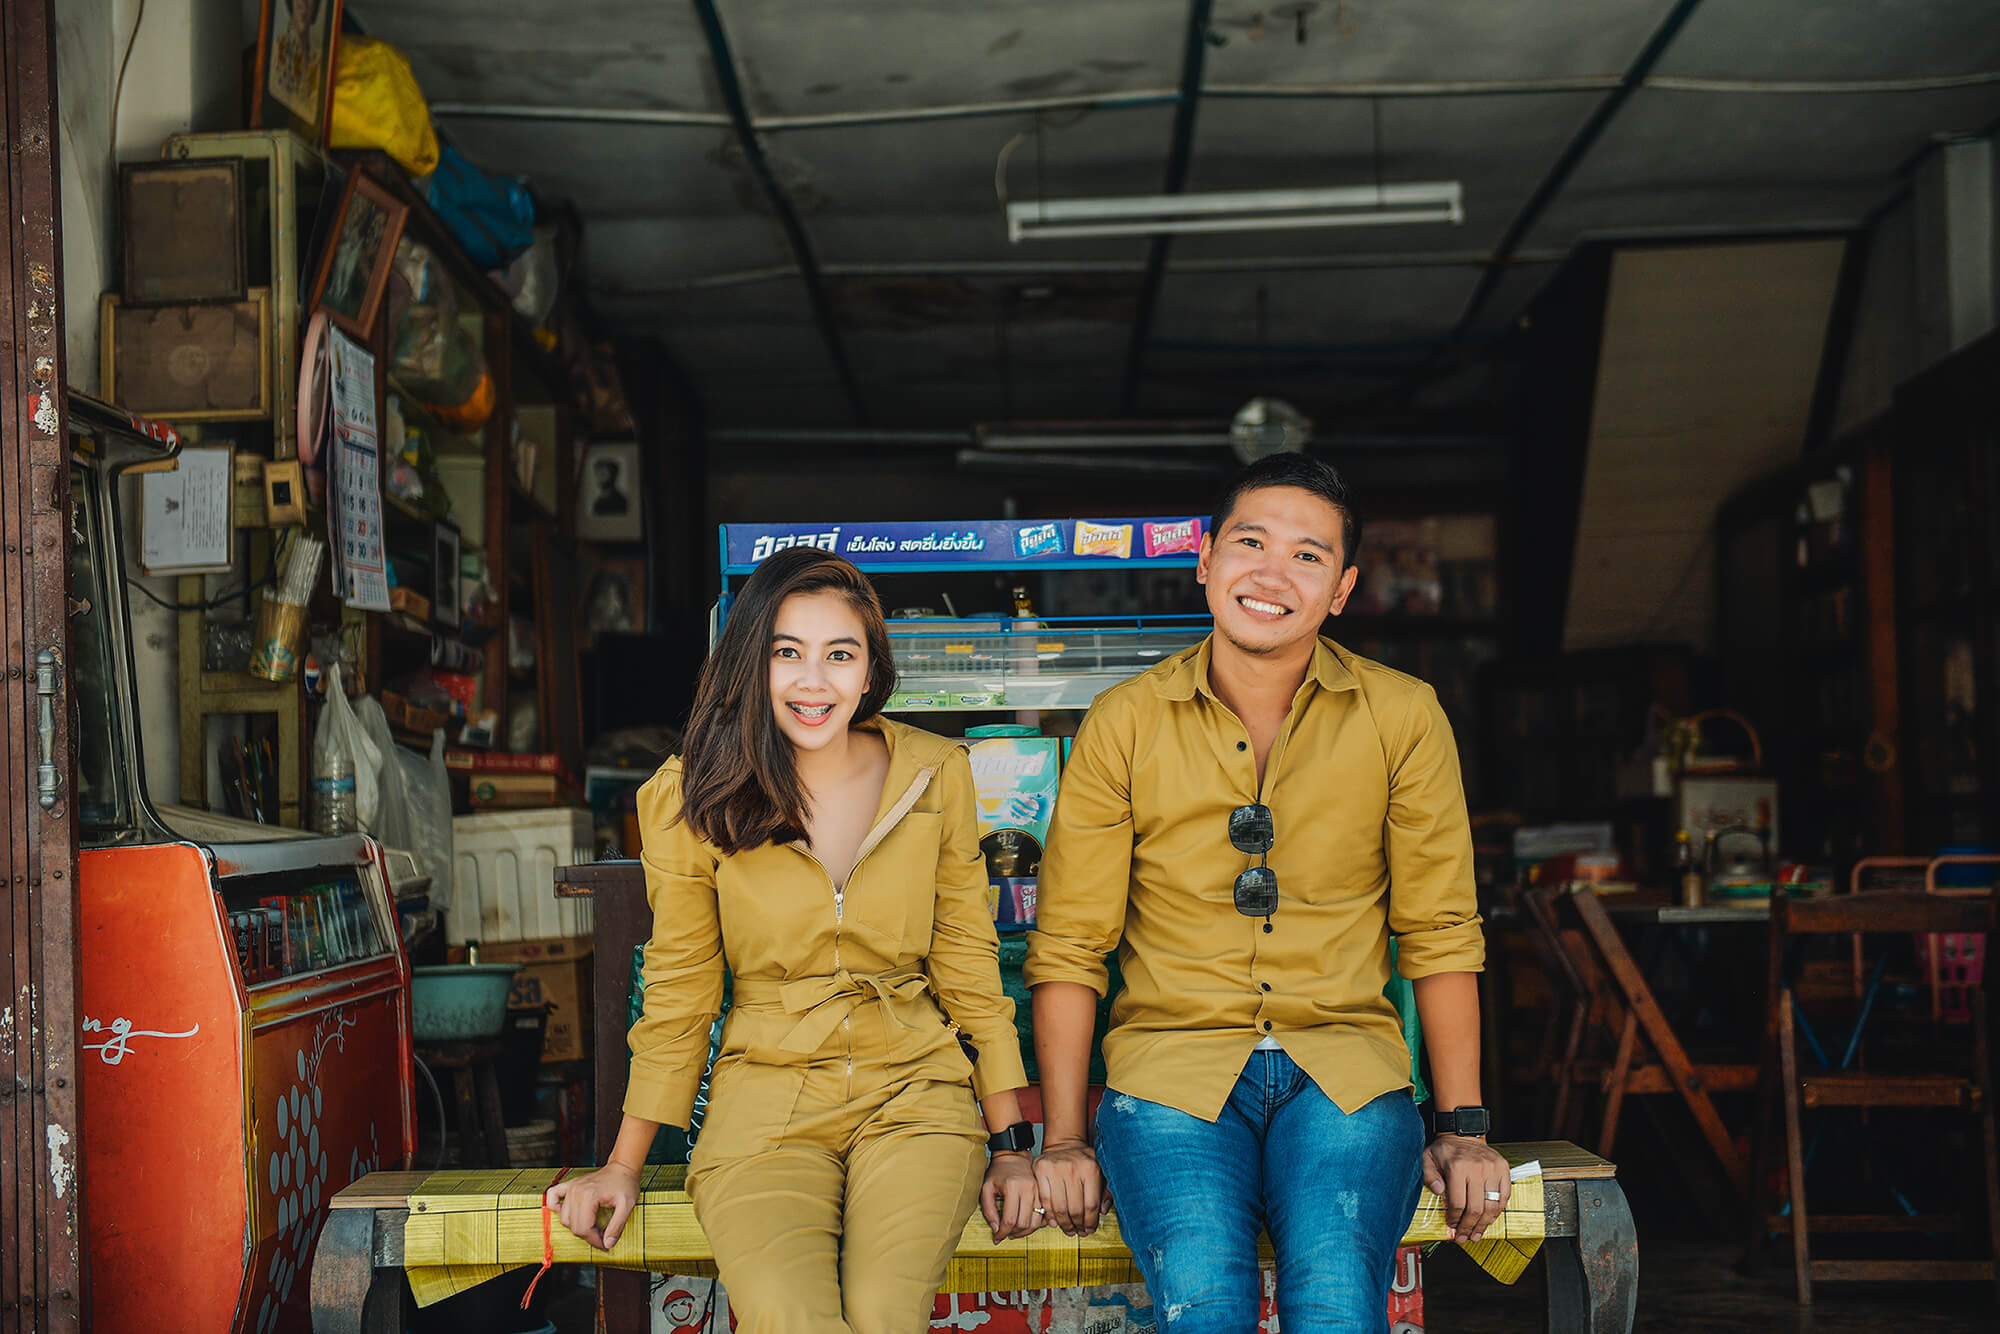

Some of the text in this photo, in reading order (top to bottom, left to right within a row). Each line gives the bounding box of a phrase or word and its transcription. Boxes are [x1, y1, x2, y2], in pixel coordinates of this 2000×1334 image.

[846, 536, 896, 552] เย็นโล่ง
[900, 531, 984, 551] สดชื่นยิ่งขึ้น
